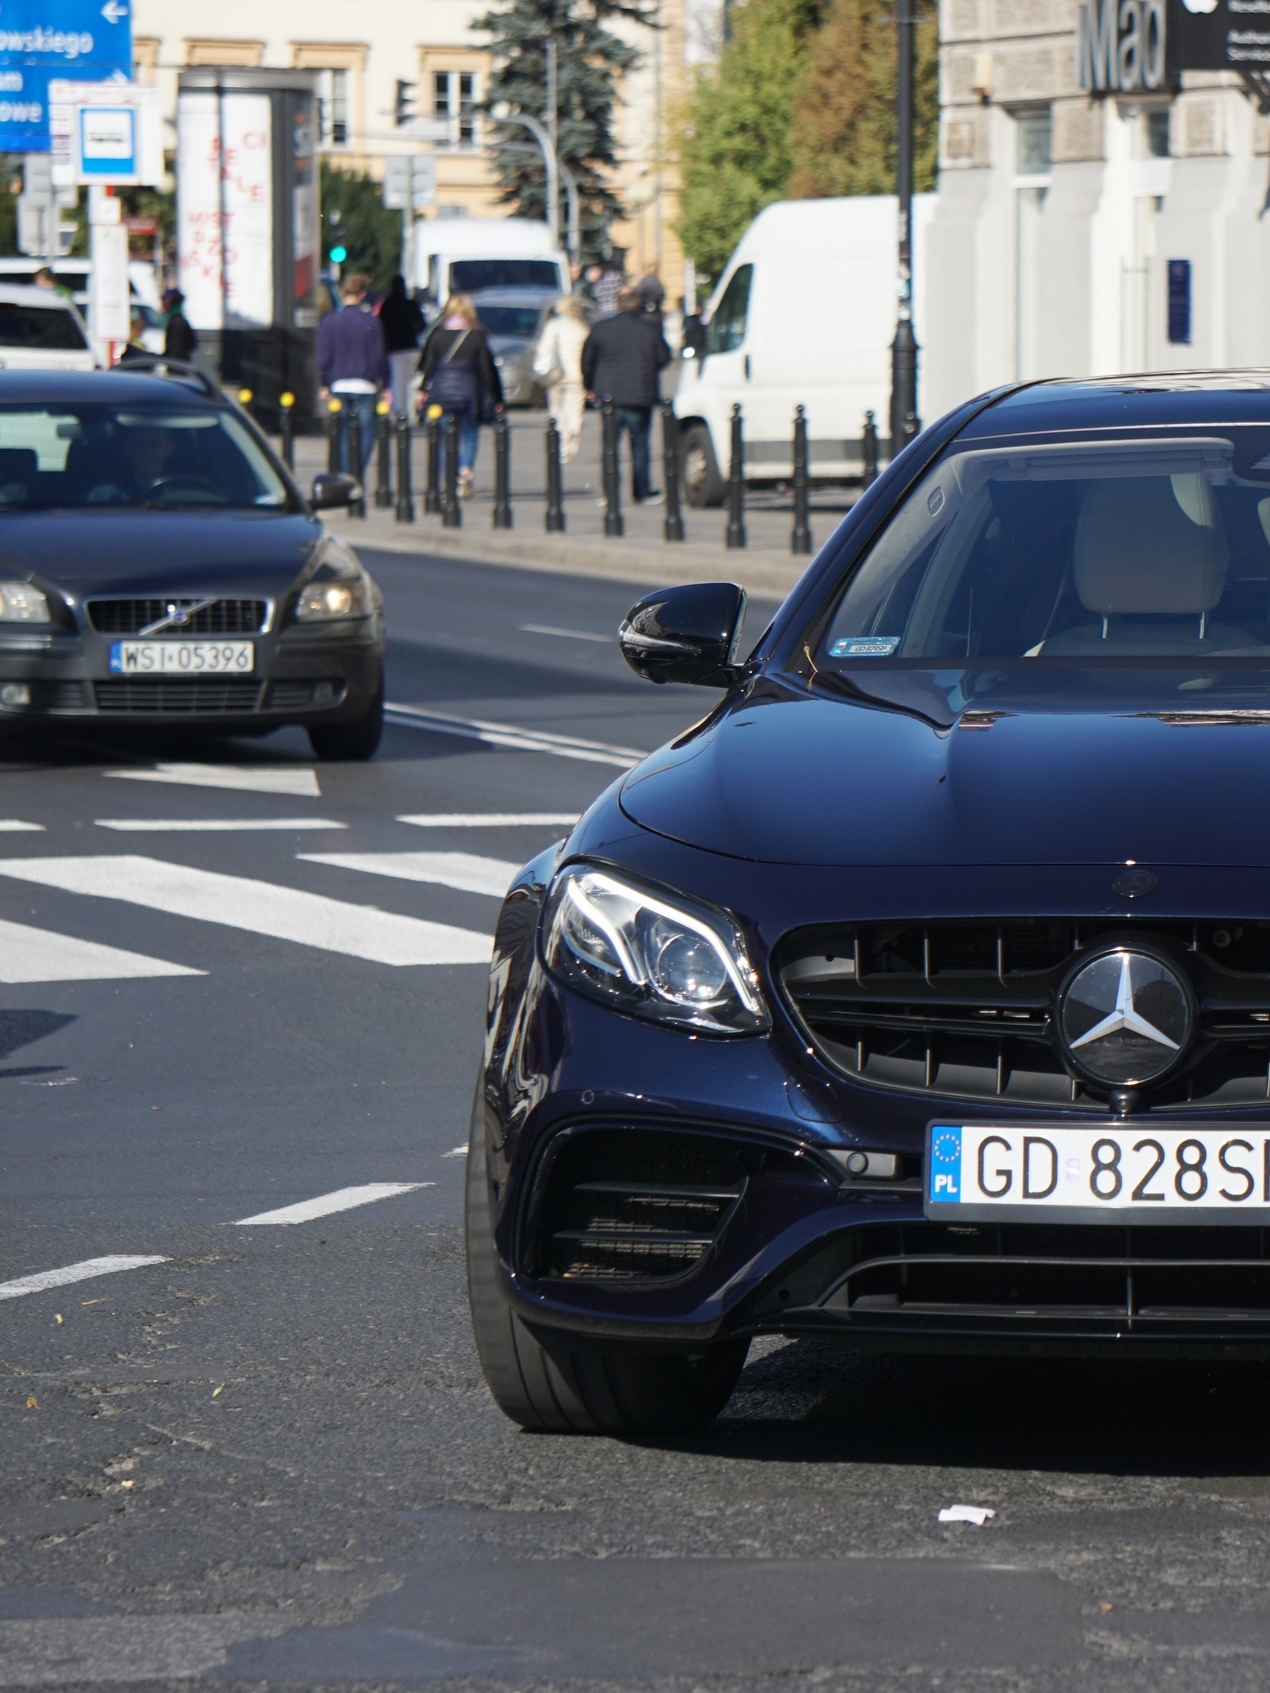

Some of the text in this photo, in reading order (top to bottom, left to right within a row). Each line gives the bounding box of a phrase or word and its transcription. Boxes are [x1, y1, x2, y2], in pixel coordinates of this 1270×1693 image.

[178, 646, 250, 669] 05396
[977, 1135, 1058, 1200] GD
[934, 1175, 958, 1193] PL
